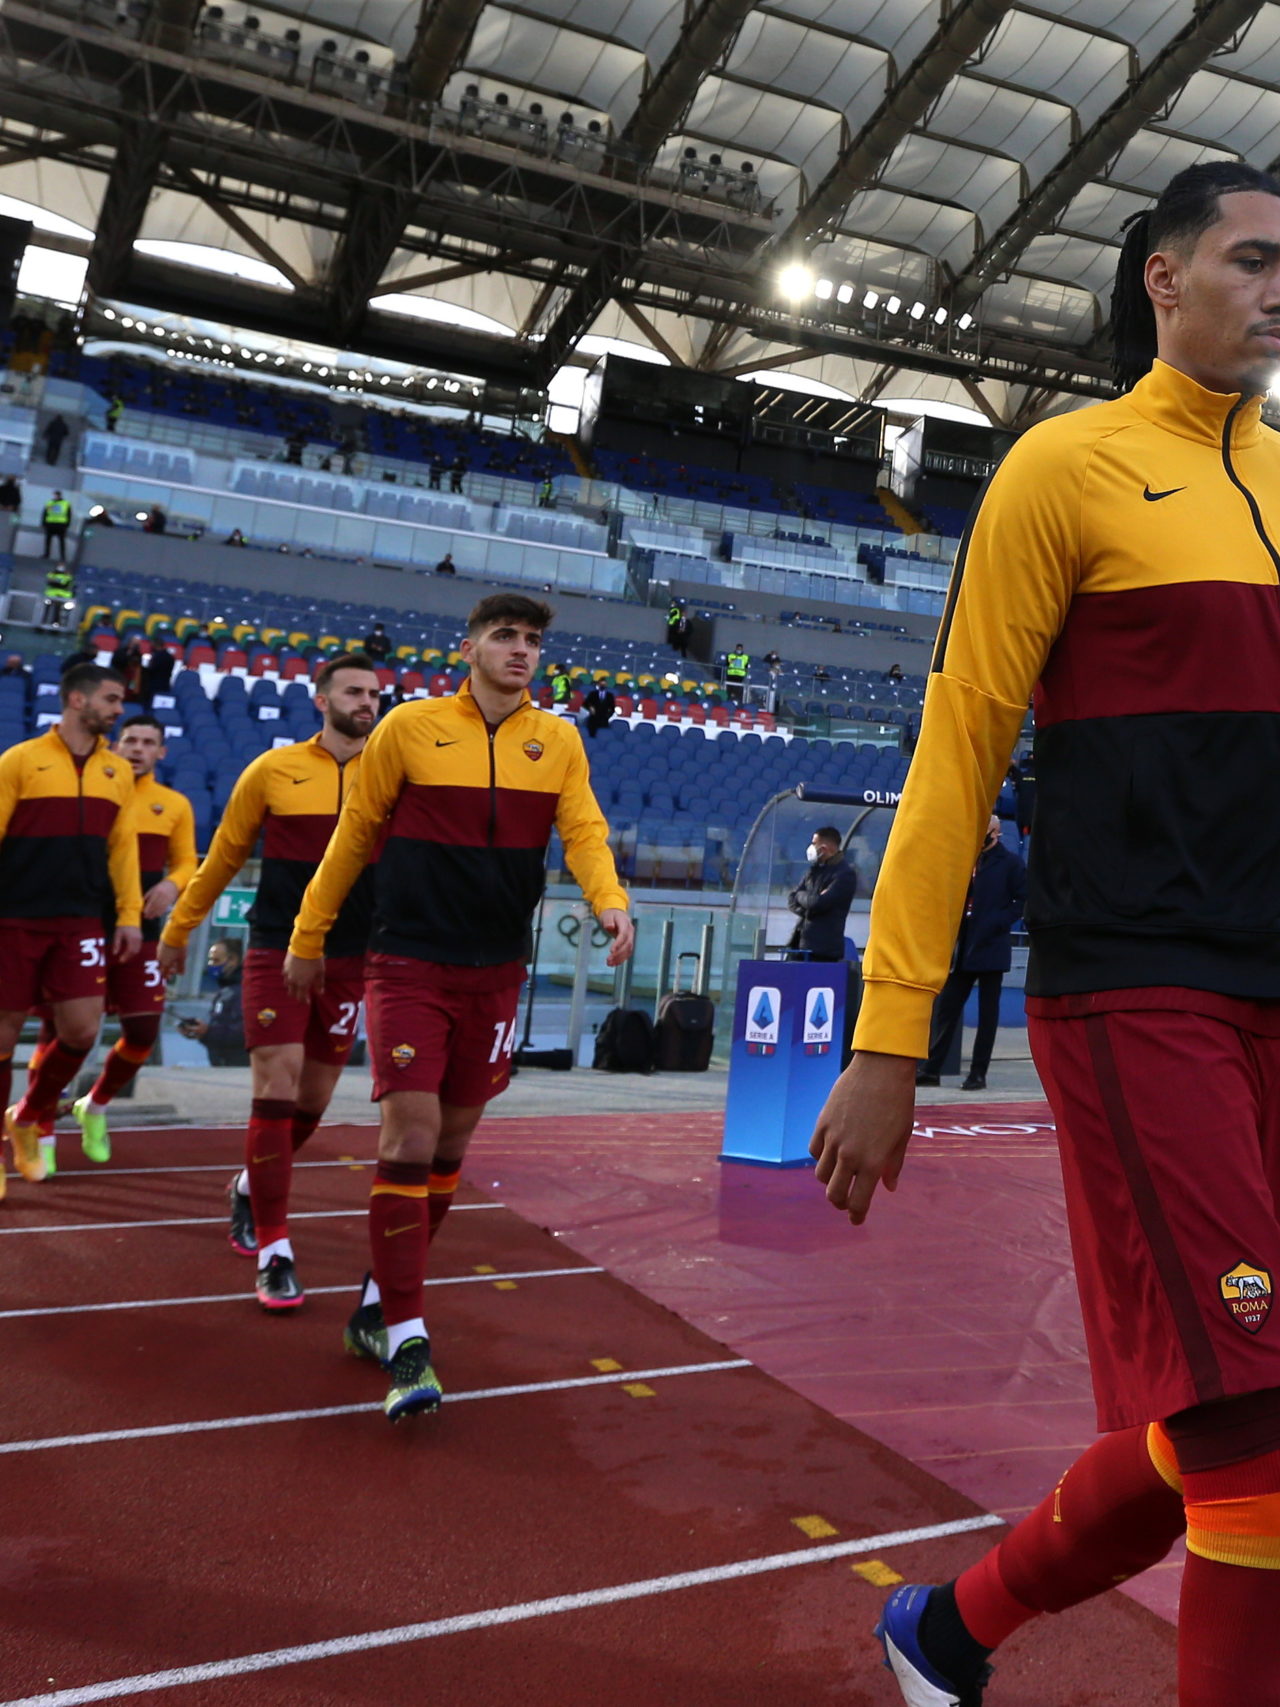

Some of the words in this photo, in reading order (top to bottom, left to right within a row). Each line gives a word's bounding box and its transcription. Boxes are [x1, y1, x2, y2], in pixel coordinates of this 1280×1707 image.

[863, 789, 903, 805] OLIM
[143, 960, 167, 988] 3
[329, 1000, 364, 1036] 2
[749, 1031, 767, 1040] SERIE
[768, 1033, 775, 1041] A
[806, 1032, 823, 1040] SERIE
[824, 1031, 829, 1039] A
[1232, 1301, 1268, 1313] ROMA
[1244, 1314, 1261, 1323] 1927
